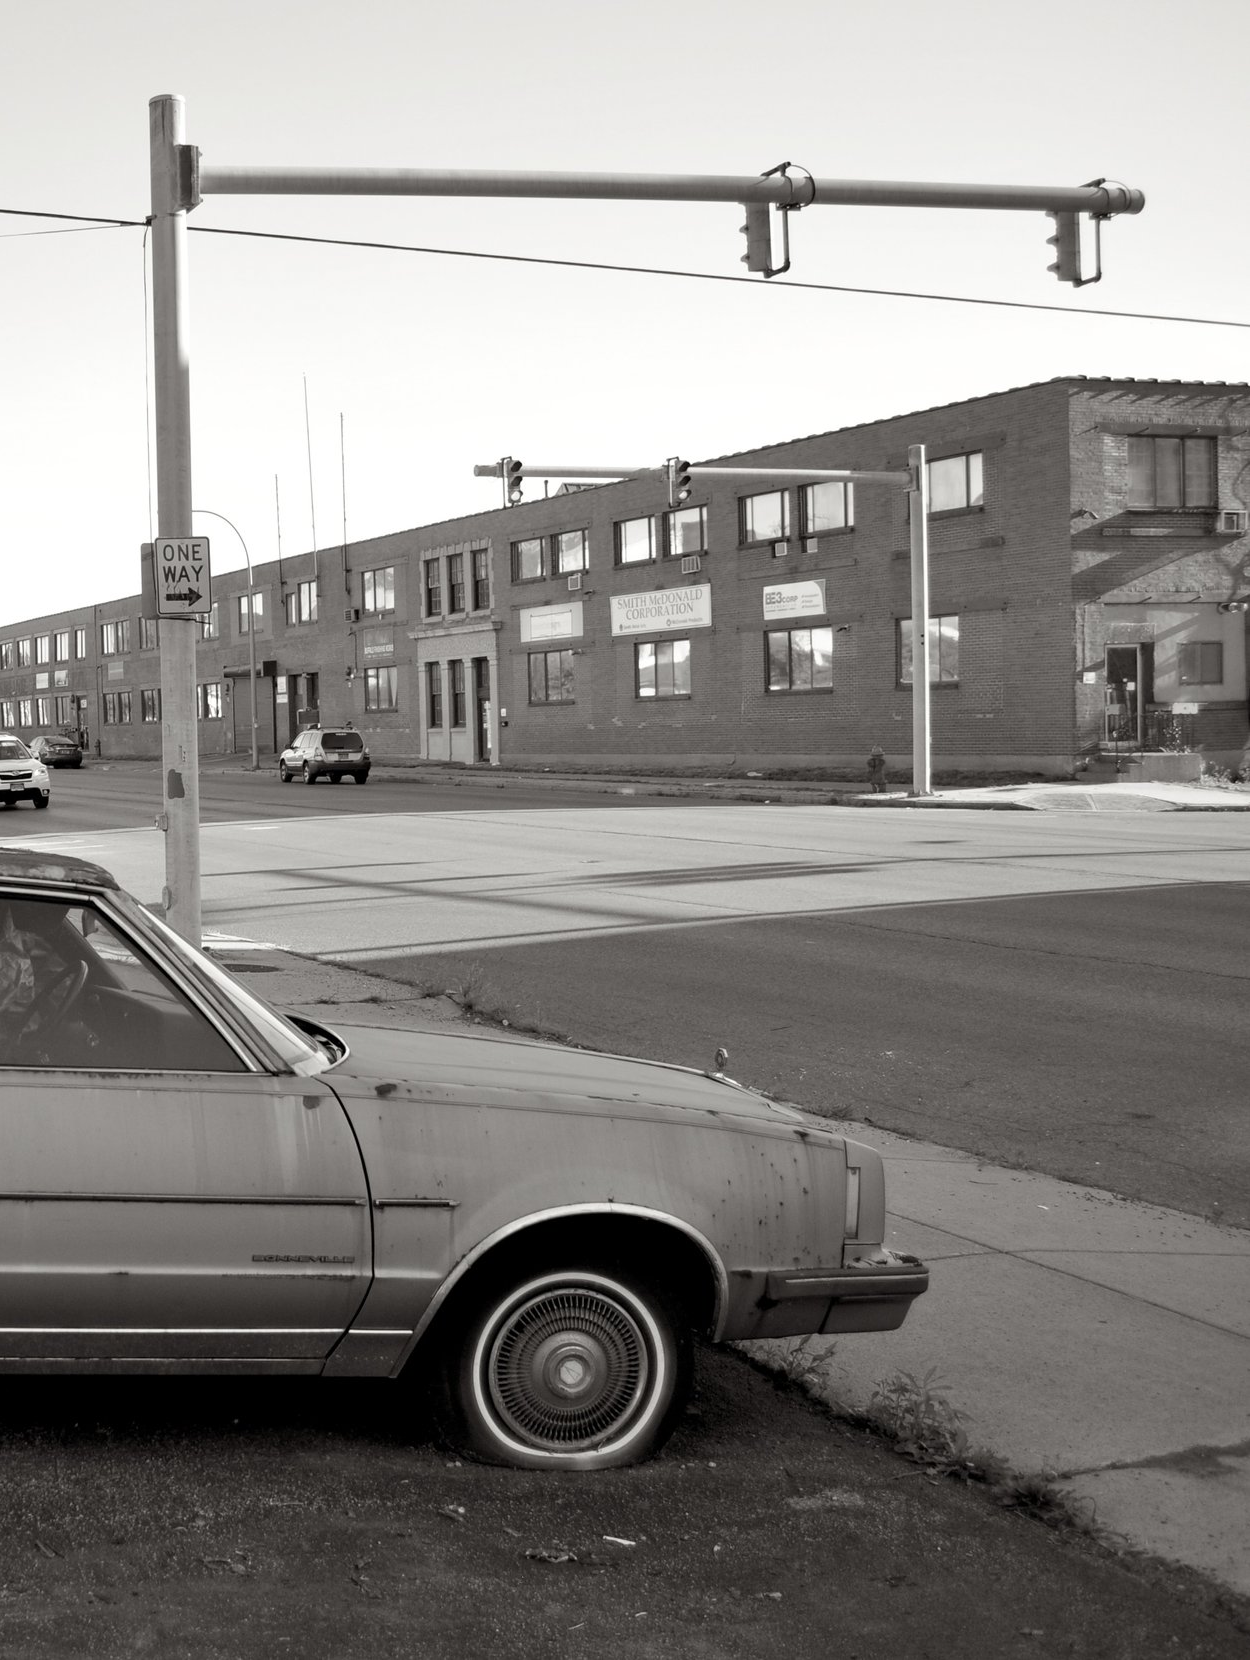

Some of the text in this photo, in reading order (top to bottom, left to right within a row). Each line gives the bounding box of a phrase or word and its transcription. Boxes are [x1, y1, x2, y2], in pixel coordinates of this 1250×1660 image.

[163, 544, 203, 561] ONE
[163, 565, 204, 583] WAY
[617, 588, 703, 610] SMITH McDONALD
[626, 602, 694, 621] CORPORATION
